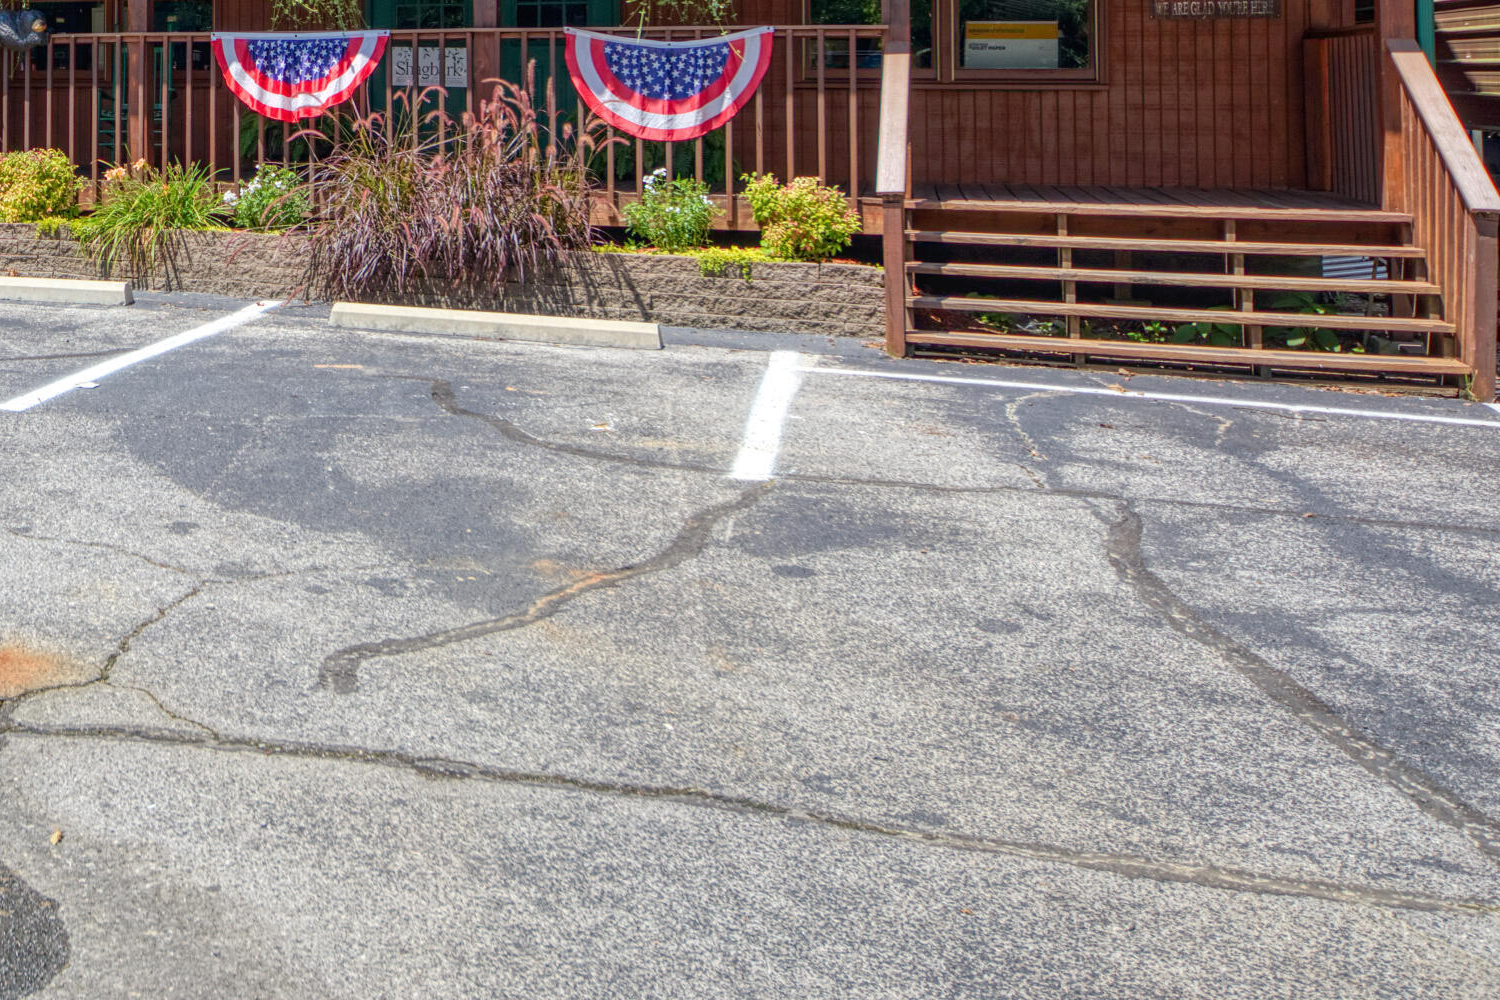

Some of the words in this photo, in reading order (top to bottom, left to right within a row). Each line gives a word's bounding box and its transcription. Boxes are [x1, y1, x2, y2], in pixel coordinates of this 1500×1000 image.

[1172, 1, 1189, 16] ARE
[1190, 1, 1215, 16] GLAD
[396, 61, 461, 80] Shgbrk
